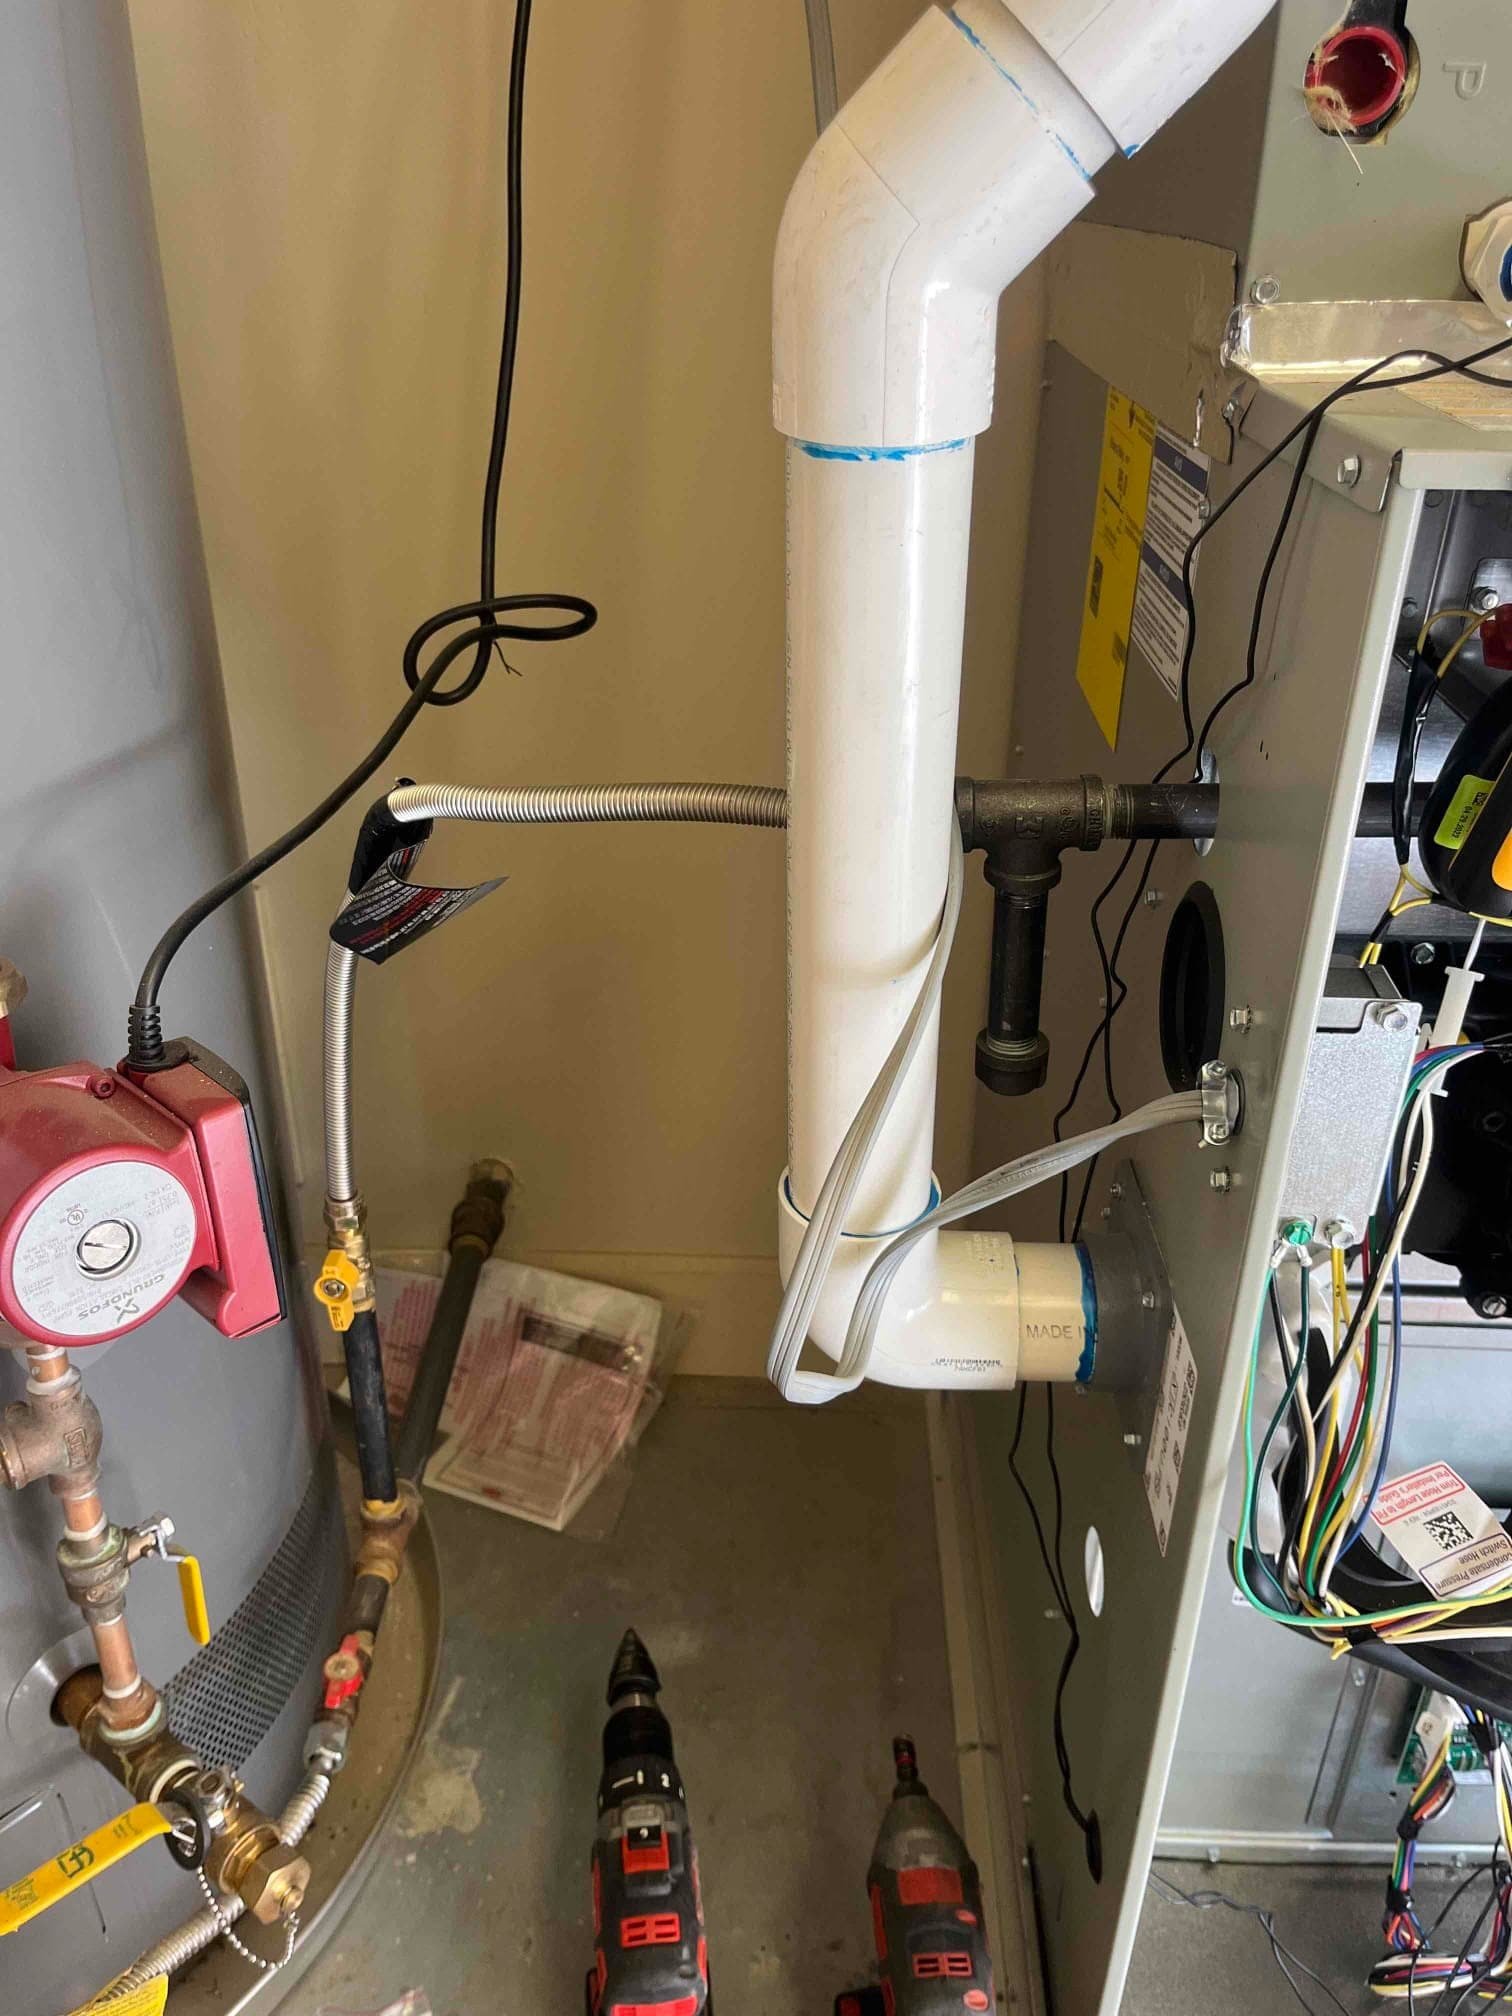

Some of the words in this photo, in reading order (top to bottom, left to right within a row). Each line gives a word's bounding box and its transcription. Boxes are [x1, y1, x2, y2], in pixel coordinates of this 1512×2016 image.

[1442, 61, 1487, 101] P
[78, 1274, 165, 1320] GRUNDFOS
[1025, 1323, 1074, 1340] MADE
[1420, 1486, 1442, 1498] Hose
[1440, 1479, 1459, 1490] Trim
[1459, 1550, 1480, 1564] Hose
[1479, 1540, 1509, 1557] Switch
[1435, 1571, 1470, 1590] Pressure
